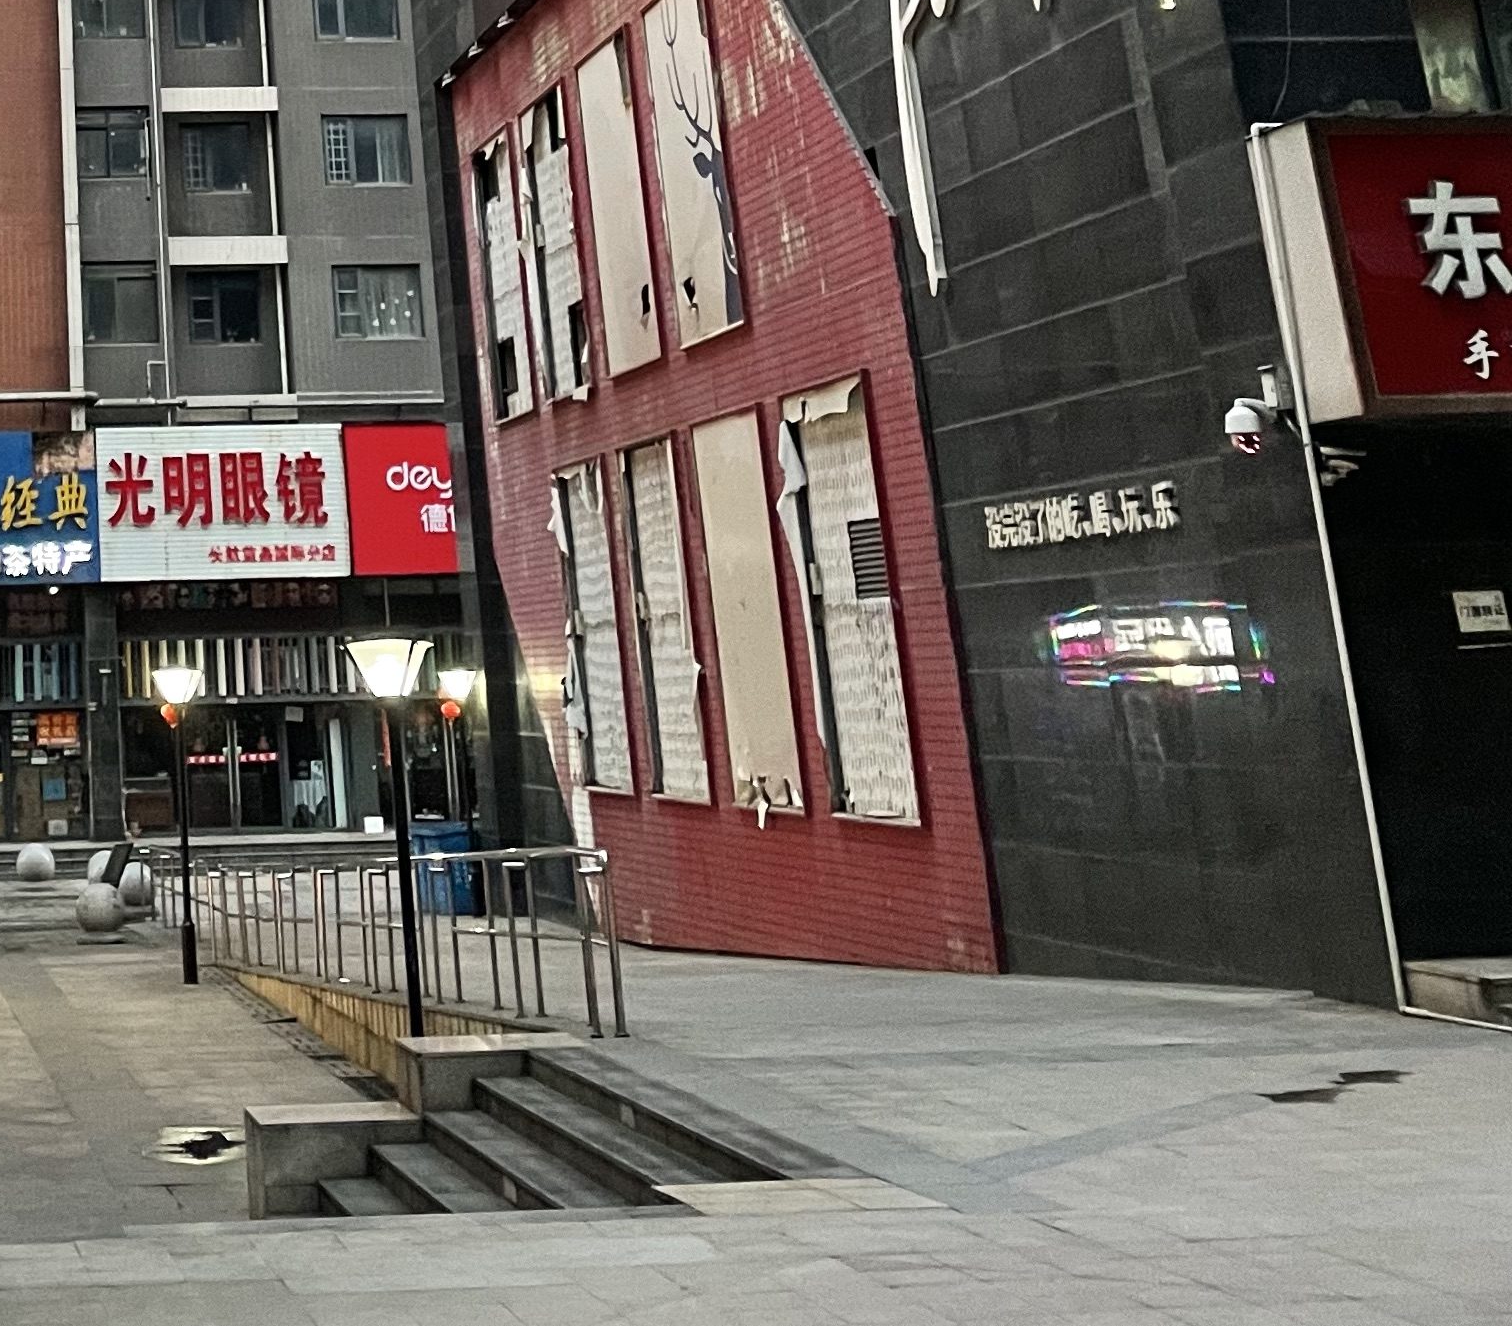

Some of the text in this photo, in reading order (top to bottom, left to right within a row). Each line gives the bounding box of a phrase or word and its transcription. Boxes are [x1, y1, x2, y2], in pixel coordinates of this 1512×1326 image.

[1401, 180, 1512, 299] 东
[1462, 328, 1512, 380] 手
[104, 451, 329, 528] 光明眼镜
